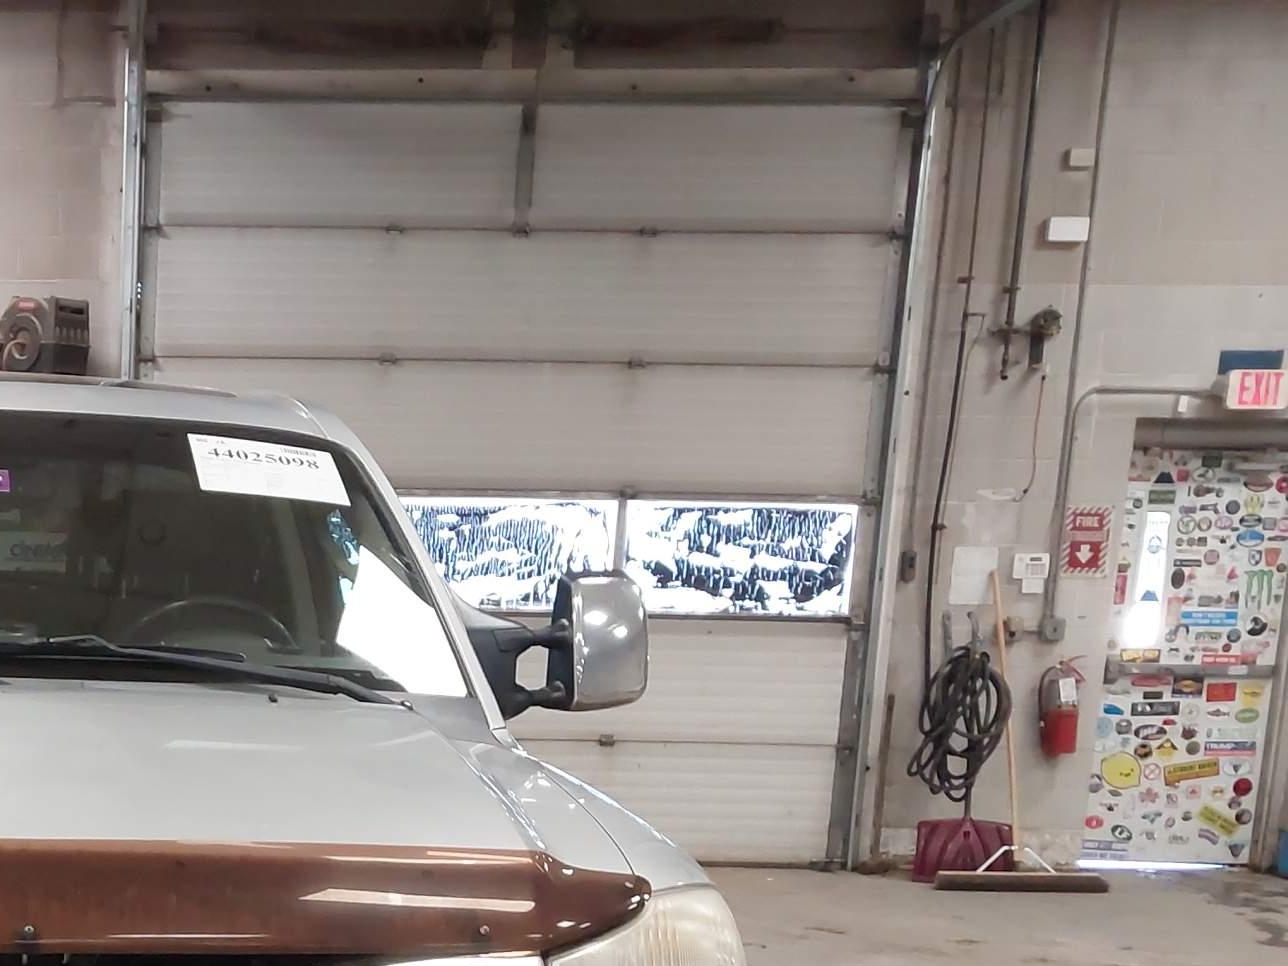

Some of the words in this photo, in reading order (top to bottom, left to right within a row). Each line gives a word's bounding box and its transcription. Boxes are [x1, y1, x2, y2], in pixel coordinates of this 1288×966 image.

[1238, 371, 1285, 405] EXIT
[208, 446, 320, 470] 44025098
[1075, 516, 1100, 528] FIRE
